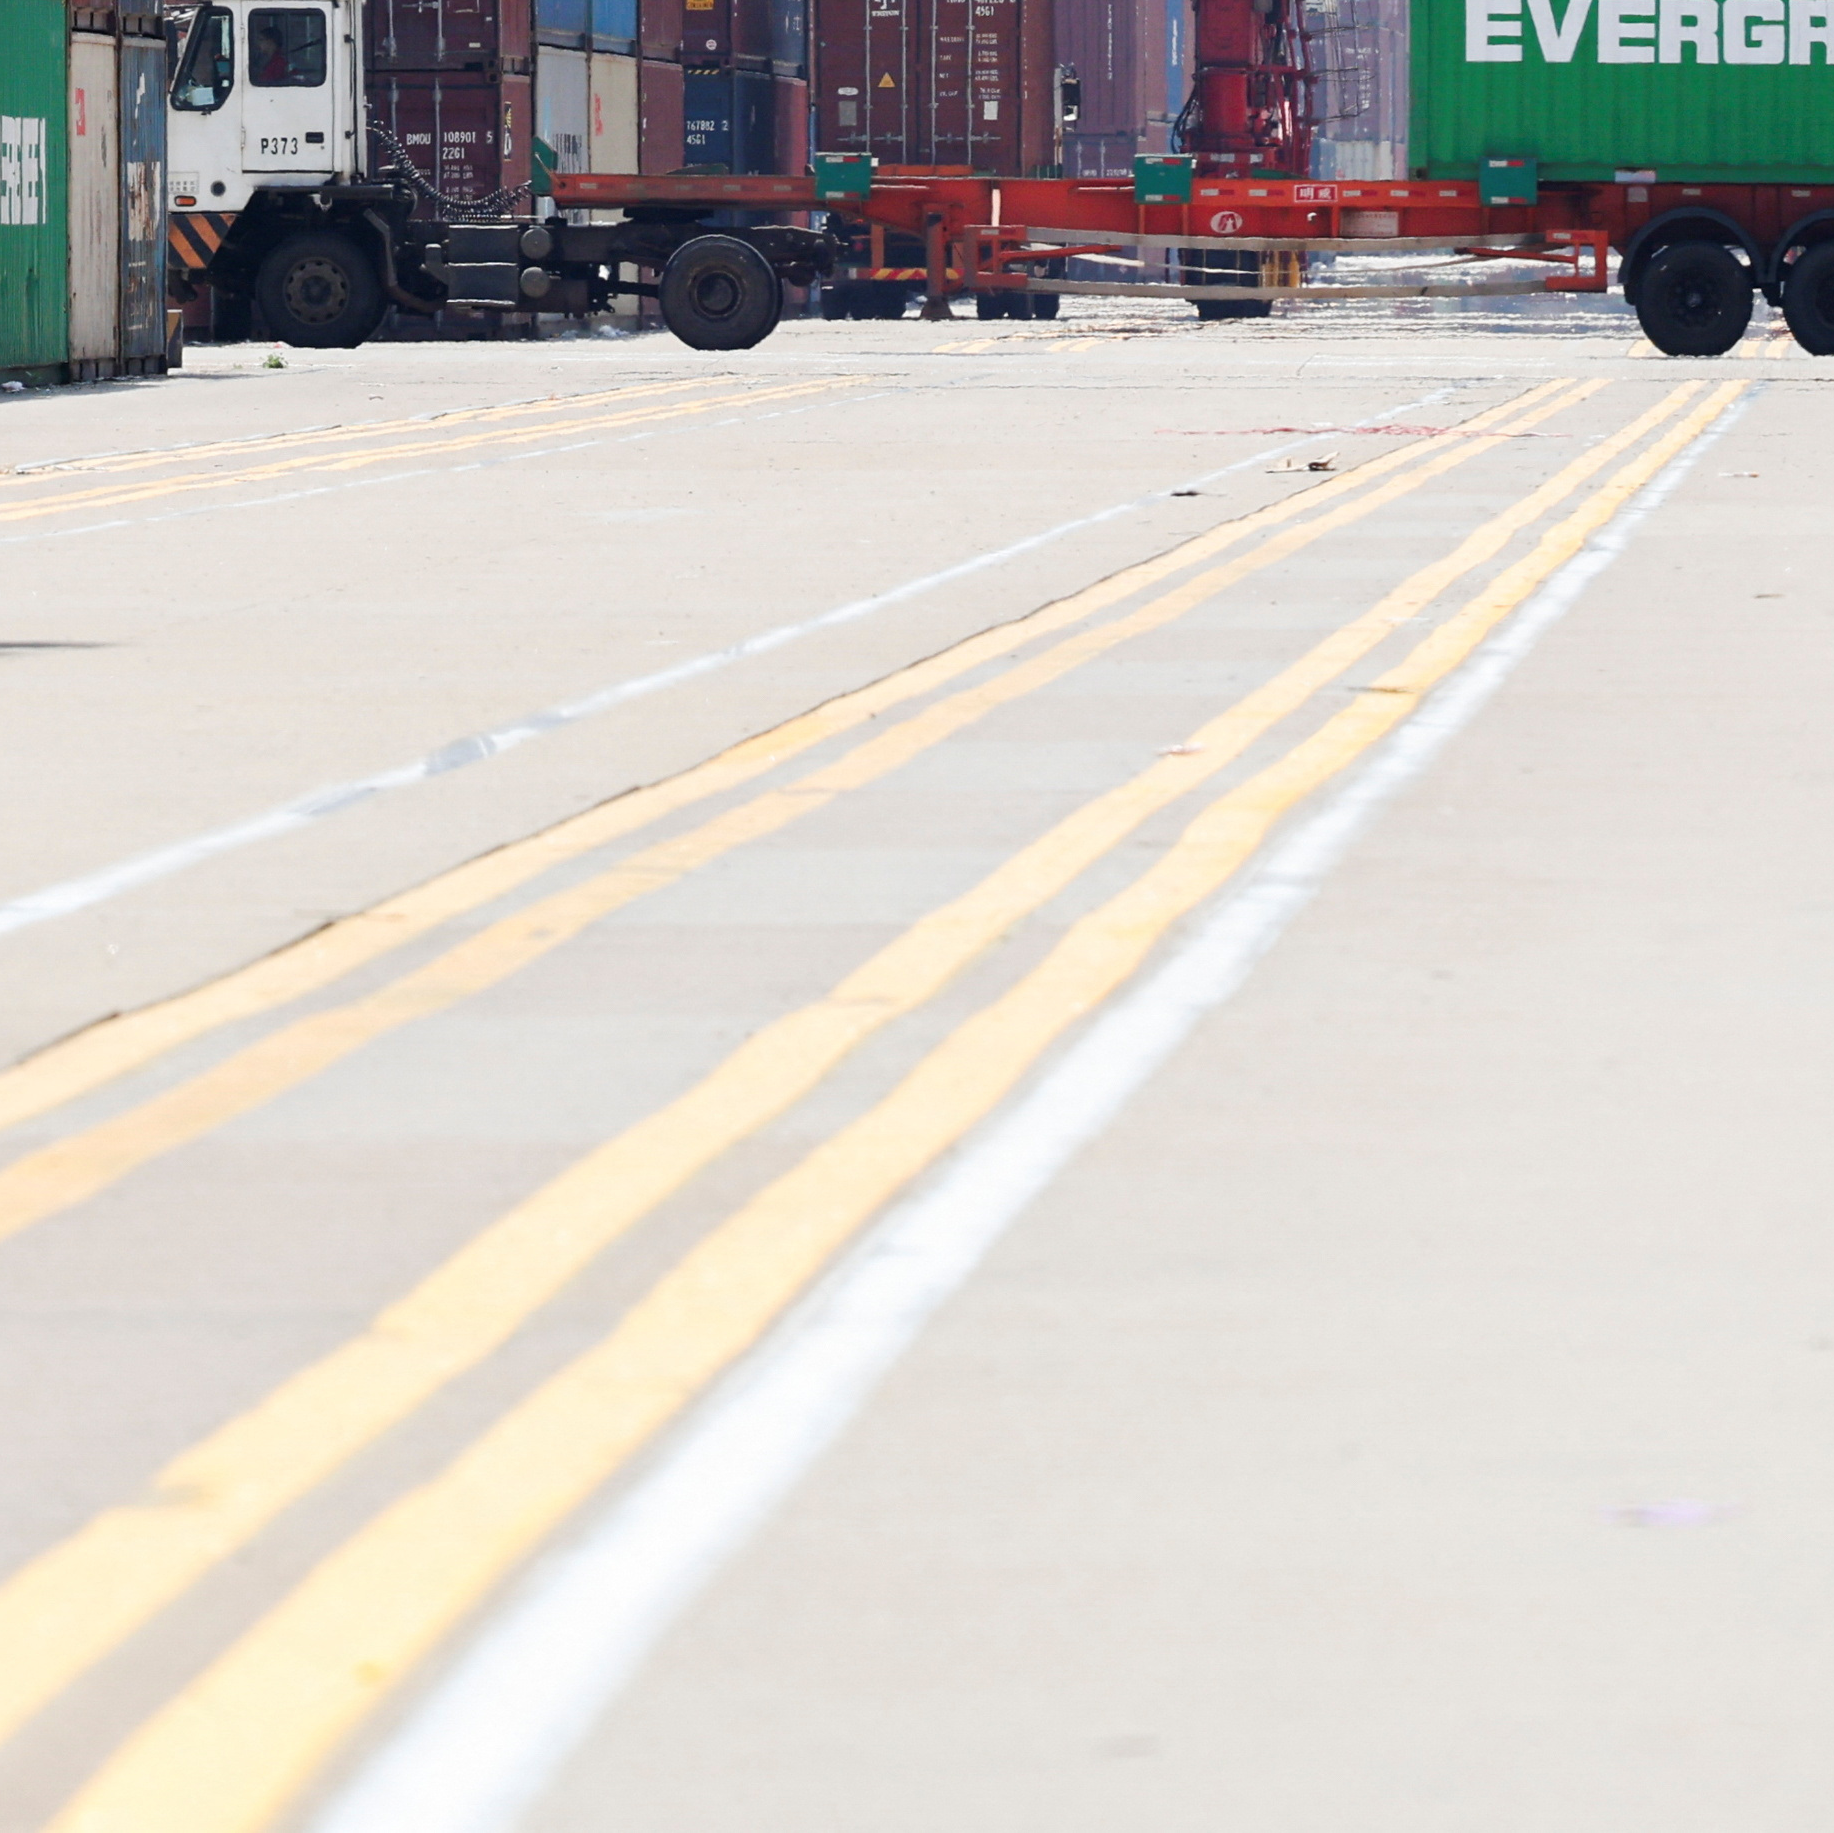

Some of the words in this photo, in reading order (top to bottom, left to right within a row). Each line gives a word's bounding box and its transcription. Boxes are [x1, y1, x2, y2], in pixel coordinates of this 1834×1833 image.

[443, 131, 476, 144] 108901
[686, 134, 706, 145] 45G1
[260, 137, 299, 155] P373
